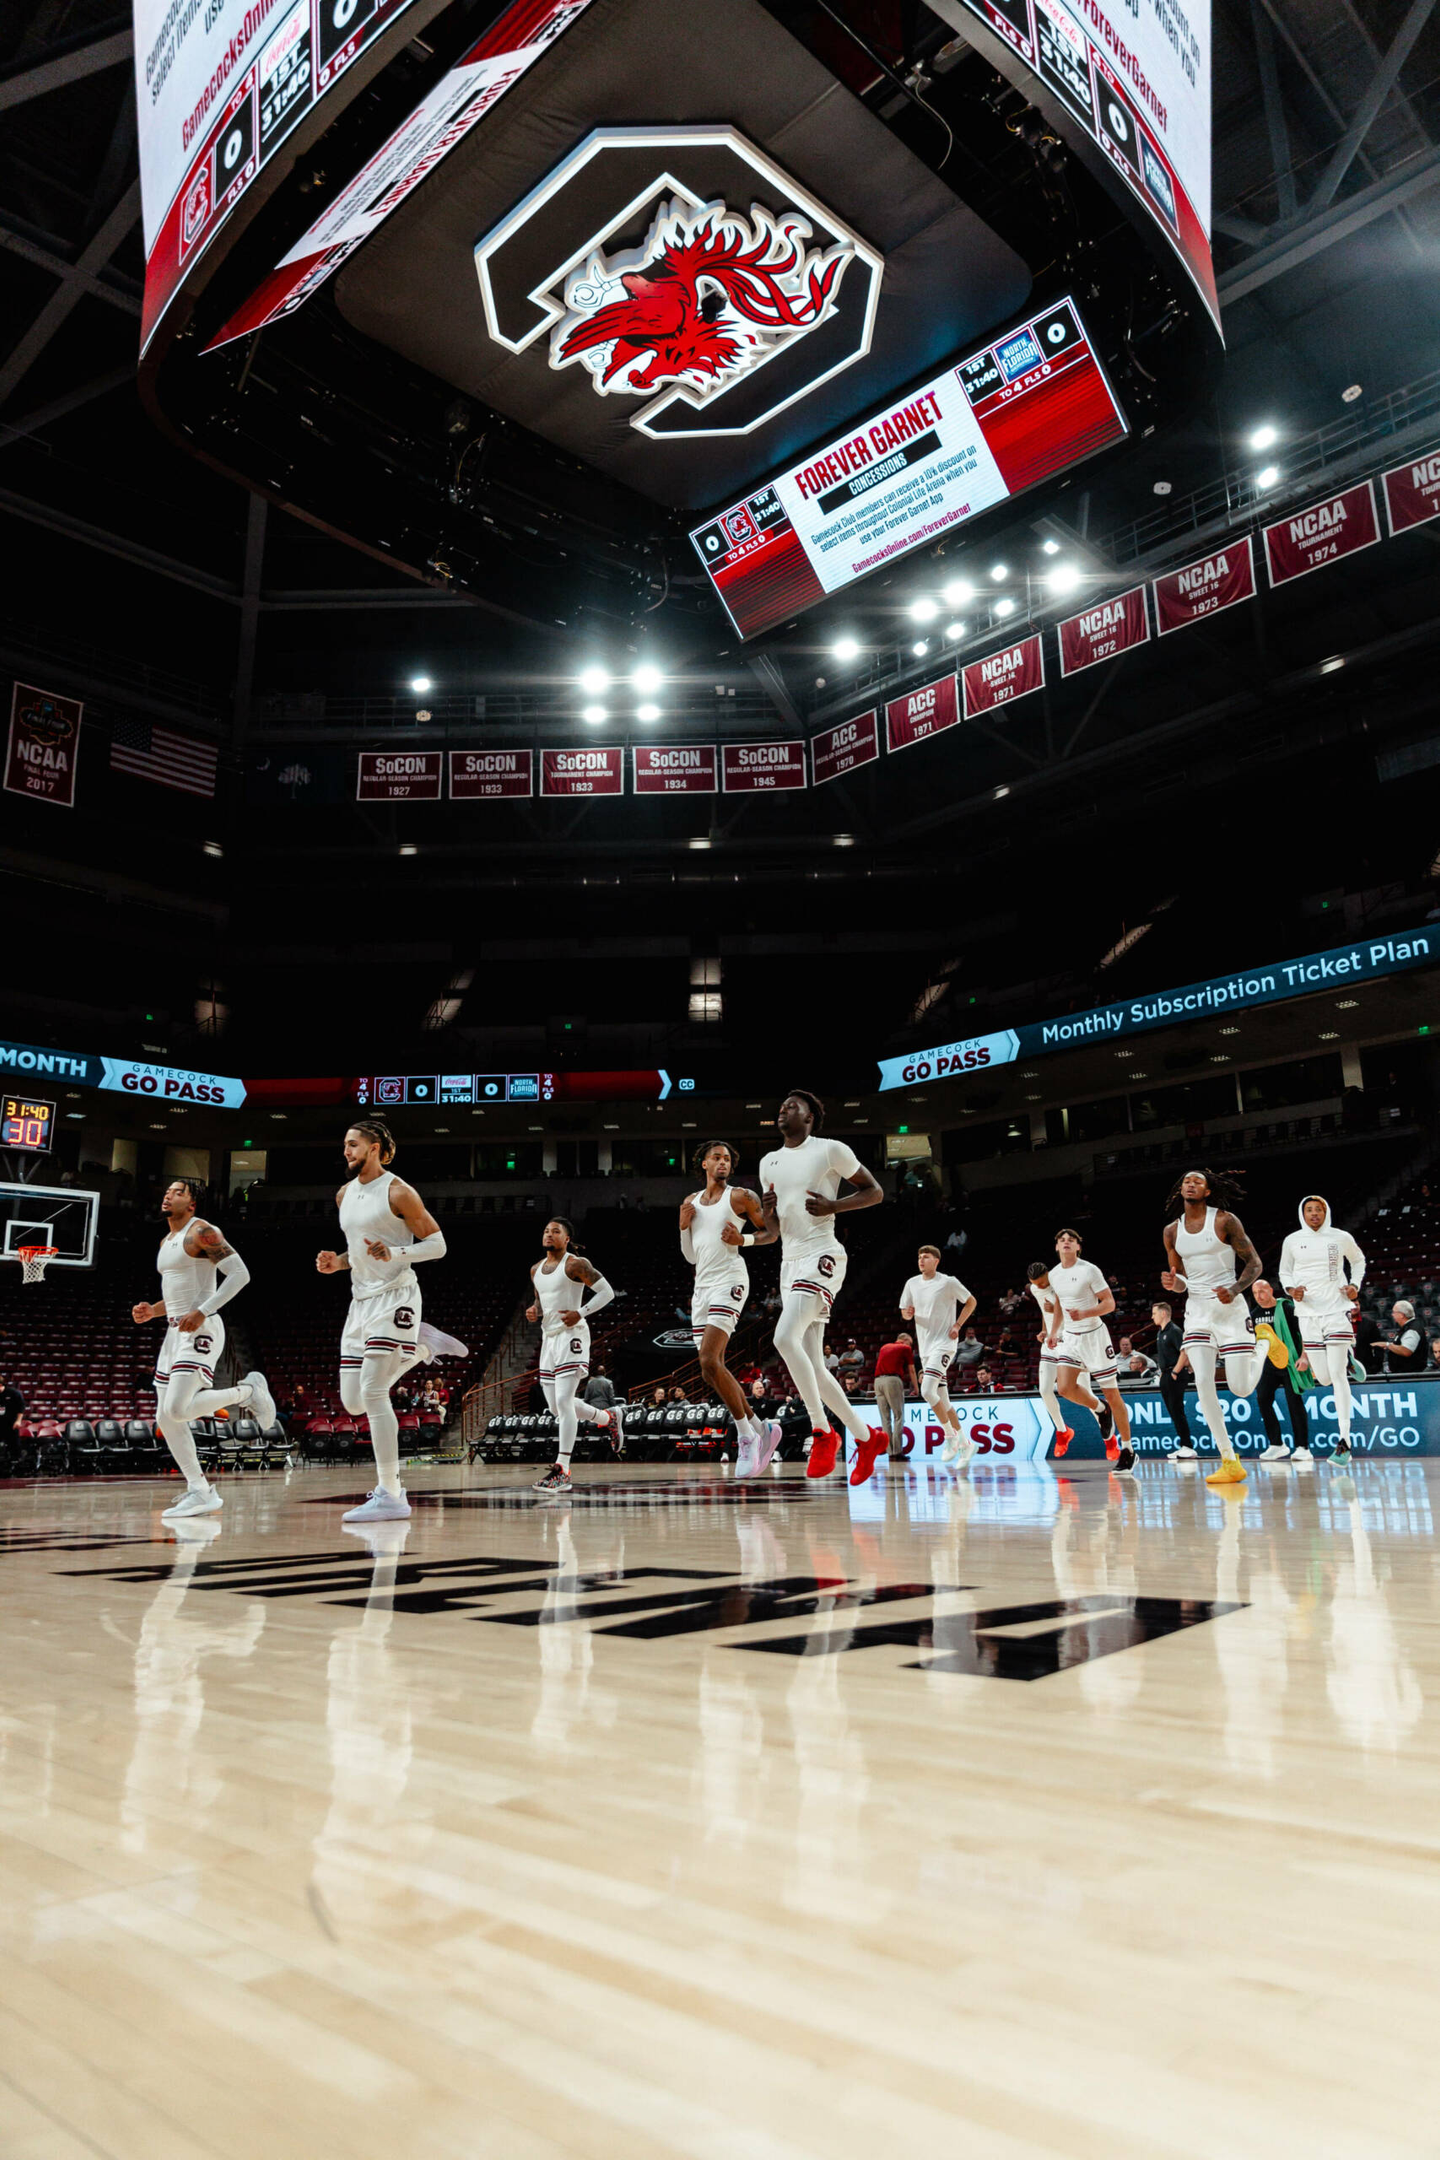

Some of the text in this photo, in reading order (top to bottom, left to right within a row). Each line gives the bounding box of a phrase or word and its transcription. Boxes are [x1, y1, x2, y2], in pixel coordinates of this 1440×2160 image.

[146, 0, 184, 86] Gamecoc
[1047, 20, 1080, 67] 1ST
[152, 36, 175, 106] select
[270, 38, 302, 92] 1ST
[1040, 34, 1091, 104] 31:40
[1076, 0, 1168, 133] oreverGarnet
[1181, 42, 1195, 88] you
[261, 61, 311, 131] 31:40
[1108, 103, 1128, 142] 0
[224, 129, 243, 169] 0
[1047, 322, 1066, 344] 0
[1001, 336, 1029, 359] NORTH
[965, 356, 986, 376] 1ST
[965, 367, 999, 394] 31:40
[998, 388, 1013, 400] TO
[1013, 381, 1023, 392] 4
[1023, 371, 1042, 386] FLS
[1041, 364, 1051, 376] 0
[794, 390, 943, 500] FOREVER GARNET
[848, 452, 908, 496] CONCESSIONS
[753, 491, 770, 507] 1ST
[811, 444, 977, 546] Gamecock Club members can receive a 10% discount on
[820, 458, 978, 553] select items throughout Colonial Life Arena when you
[754, 501, 780, 522] 31:40
[859, 492, 944, 545] use your Forever Garnet App
[1289, 499, 1348, 544] NCAA
[705, 535, 720, 552] 0
[727, 534, 766, 561] TO 4 FLS 0
[851, 502, 972, 574] GamecocksOnline.com/ForeverGarnet
[1297, 523, 1343, 551] TOURNAMENT
[1307, 541, 1338, 565] 1974
[1177, 554, 1230, 595] NCAA
[1188, 585, 1209, 601] SWEET
[1191, 596, 1219, 616] 1973
[1079, 600, 1126, 638] NCAA
[1089, 625, 1108, 643] SWEET
[1092, 639, 1117, 660] 1972
[981, 647, 1024, 683] NCAA
[907, 688, 936, 717] ACC
[992, 685, 1014, 703] 1971
[909, 707, 935, 724] CHAMPION
[831, 723, 857, 751] ACC
[912, 721, 933, 738] 1971
[17, 738, 68, 772] NCAA
[375, 757, 426, 774] SoCON
[465, 754, 517, 773] SoCON
[556, 752, 608, 771] SoCON
[649, 749, 701, 768] SoCON
[738, 746, 790, 766] SoCON
[836, 755, 854, 772] 1970
[773, 763, 802, 772] CHAMPION
[26, 776, 55, 793] 2017
[388, 786, 411, 797] 1927
[480, 784, 503, 795] 1933
[570, 782, 593, 792] 1933
[663, 779, 687, 790] 1934
[753, 776, 776, 787] 1945
[1041, 937, 1430, 1044] Monthly Subscription Ticket Plan
[0, 1047, 87, 1077] MONTH
[909, 1039, 981, 1064] GAMECOCK
[132, 1063, 217, 1086] GAMECOCK
[902, 1046, 991, 1083] GO PASS
[121, 1072, 225, 1104] GO PASS
[358, 1083, 367, 1091] 4
[415, 1084, 428, 1098] 0
[484, 1082, 499, 1096] 0
[680, 1080, 693, 1089] CC
[7, 1101, 49, 1121] 31:40
[441, 1095, 472, 1103] 31:40
[8, 1117, 43, 1146] 30
[925, 1423, 1016, 1455] PSS
